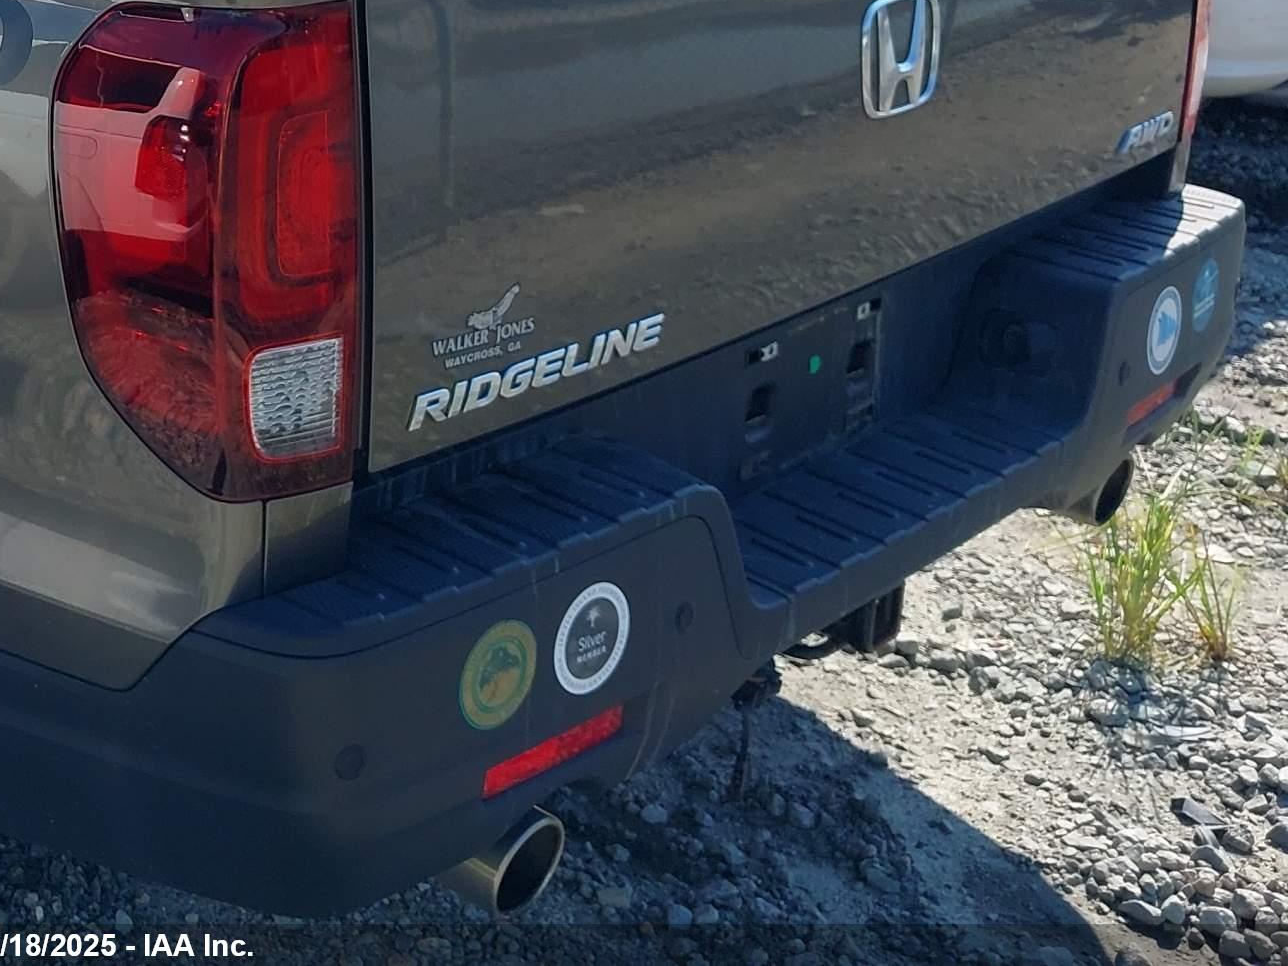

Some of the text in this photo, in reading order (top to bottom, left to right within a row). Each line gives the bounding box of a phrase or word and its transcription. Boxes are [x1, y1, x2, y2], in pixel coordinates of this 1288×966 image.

[1116, 110, 1174, 154] AWD
[432, 317, 535, 356] WALKER JONES
[508, 341, 521, 352] GA
[408, 313, 666, 432] RIDGELINE
[577, 631, 607, 652] Silver
